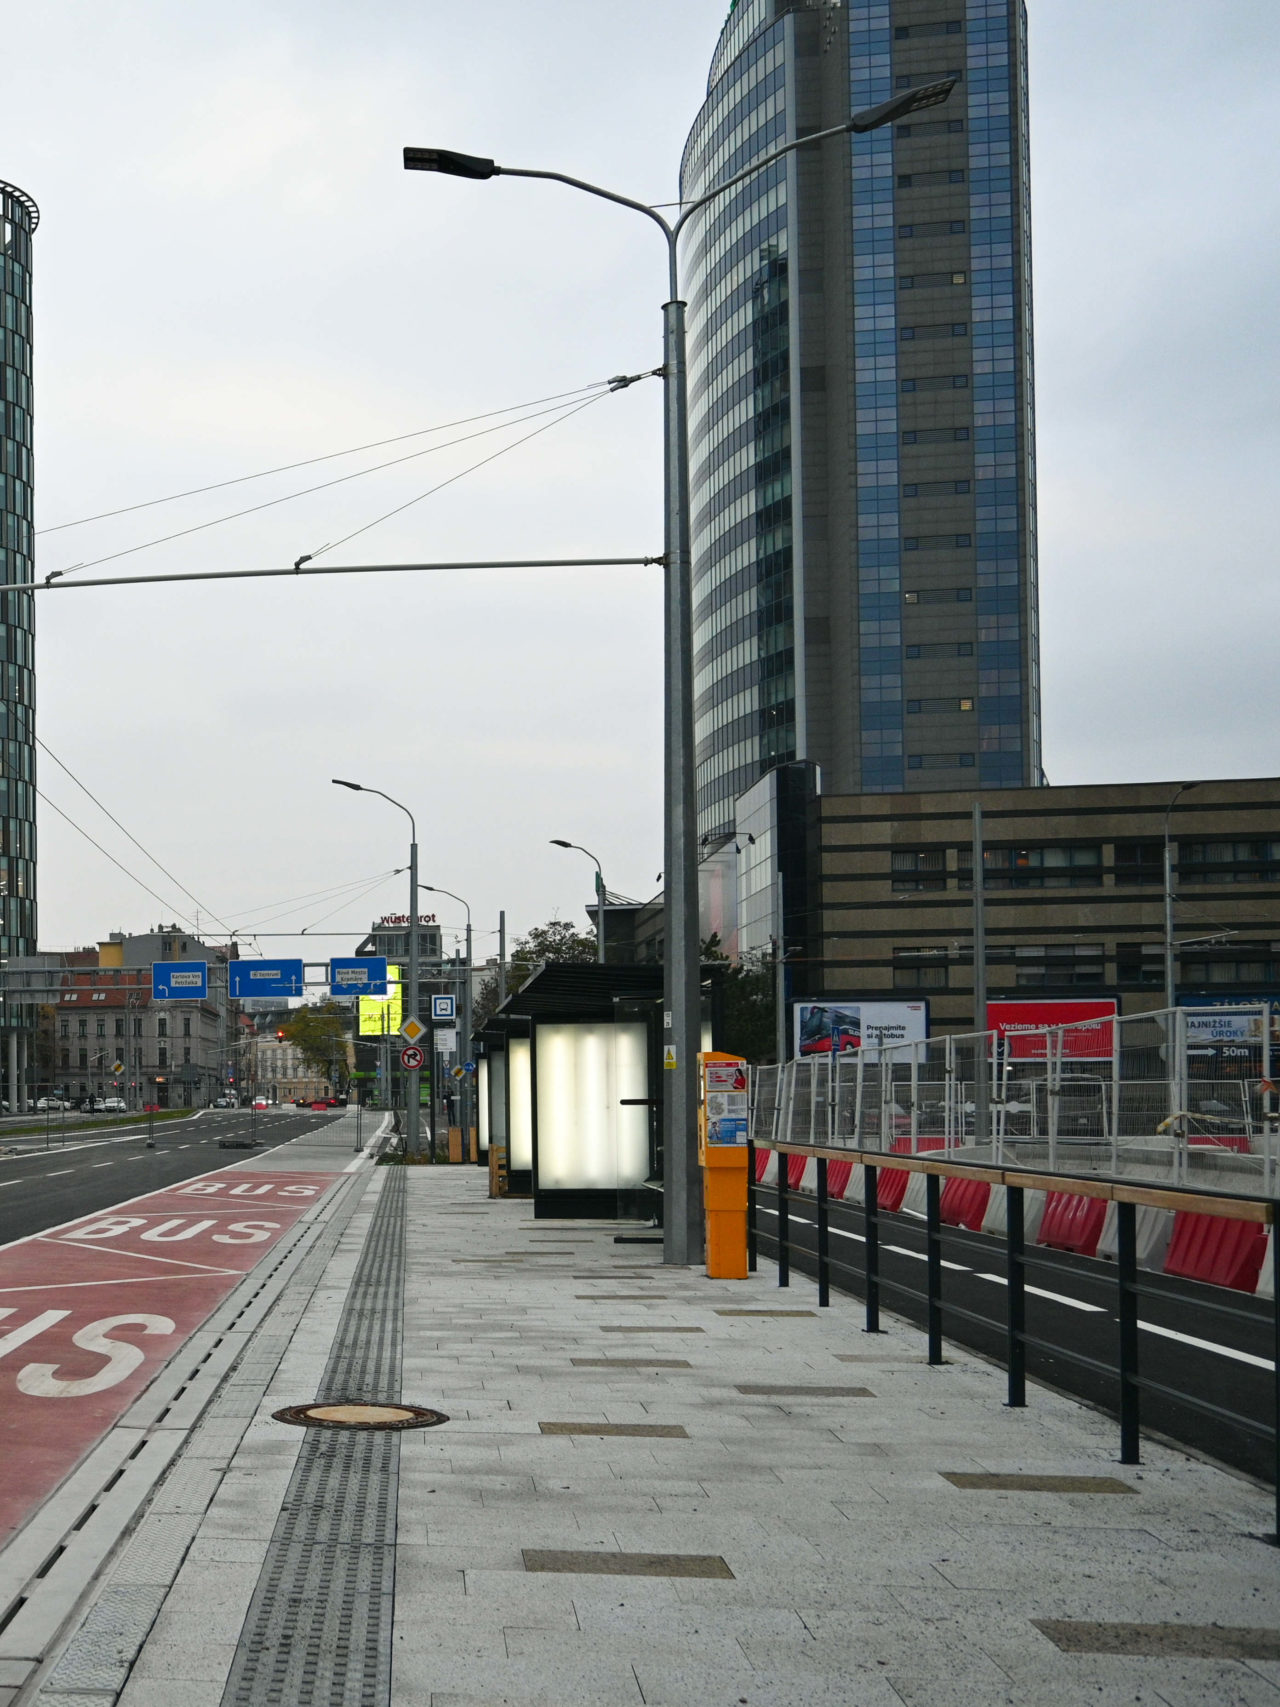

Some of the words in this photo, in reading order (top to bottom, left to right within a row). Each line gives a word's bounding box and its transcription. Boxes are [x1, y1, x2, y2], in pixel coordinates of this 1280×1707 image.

[380, 912, 436, 924] wüsterot
[866, 1024, 906, 1032] Prenajmite
[1000, 1022, 1036, 1031] Vezieme
[1186, 1019, 1233, 1028] AJNIŽŠIE
[1211, 1028, 1246, 1038] ÚROKY
[1222, 1047, 1249, 1057] 50m
[180, 1181, 320, 1197] BUS
[58, 1217, 282, 1244] BUS
